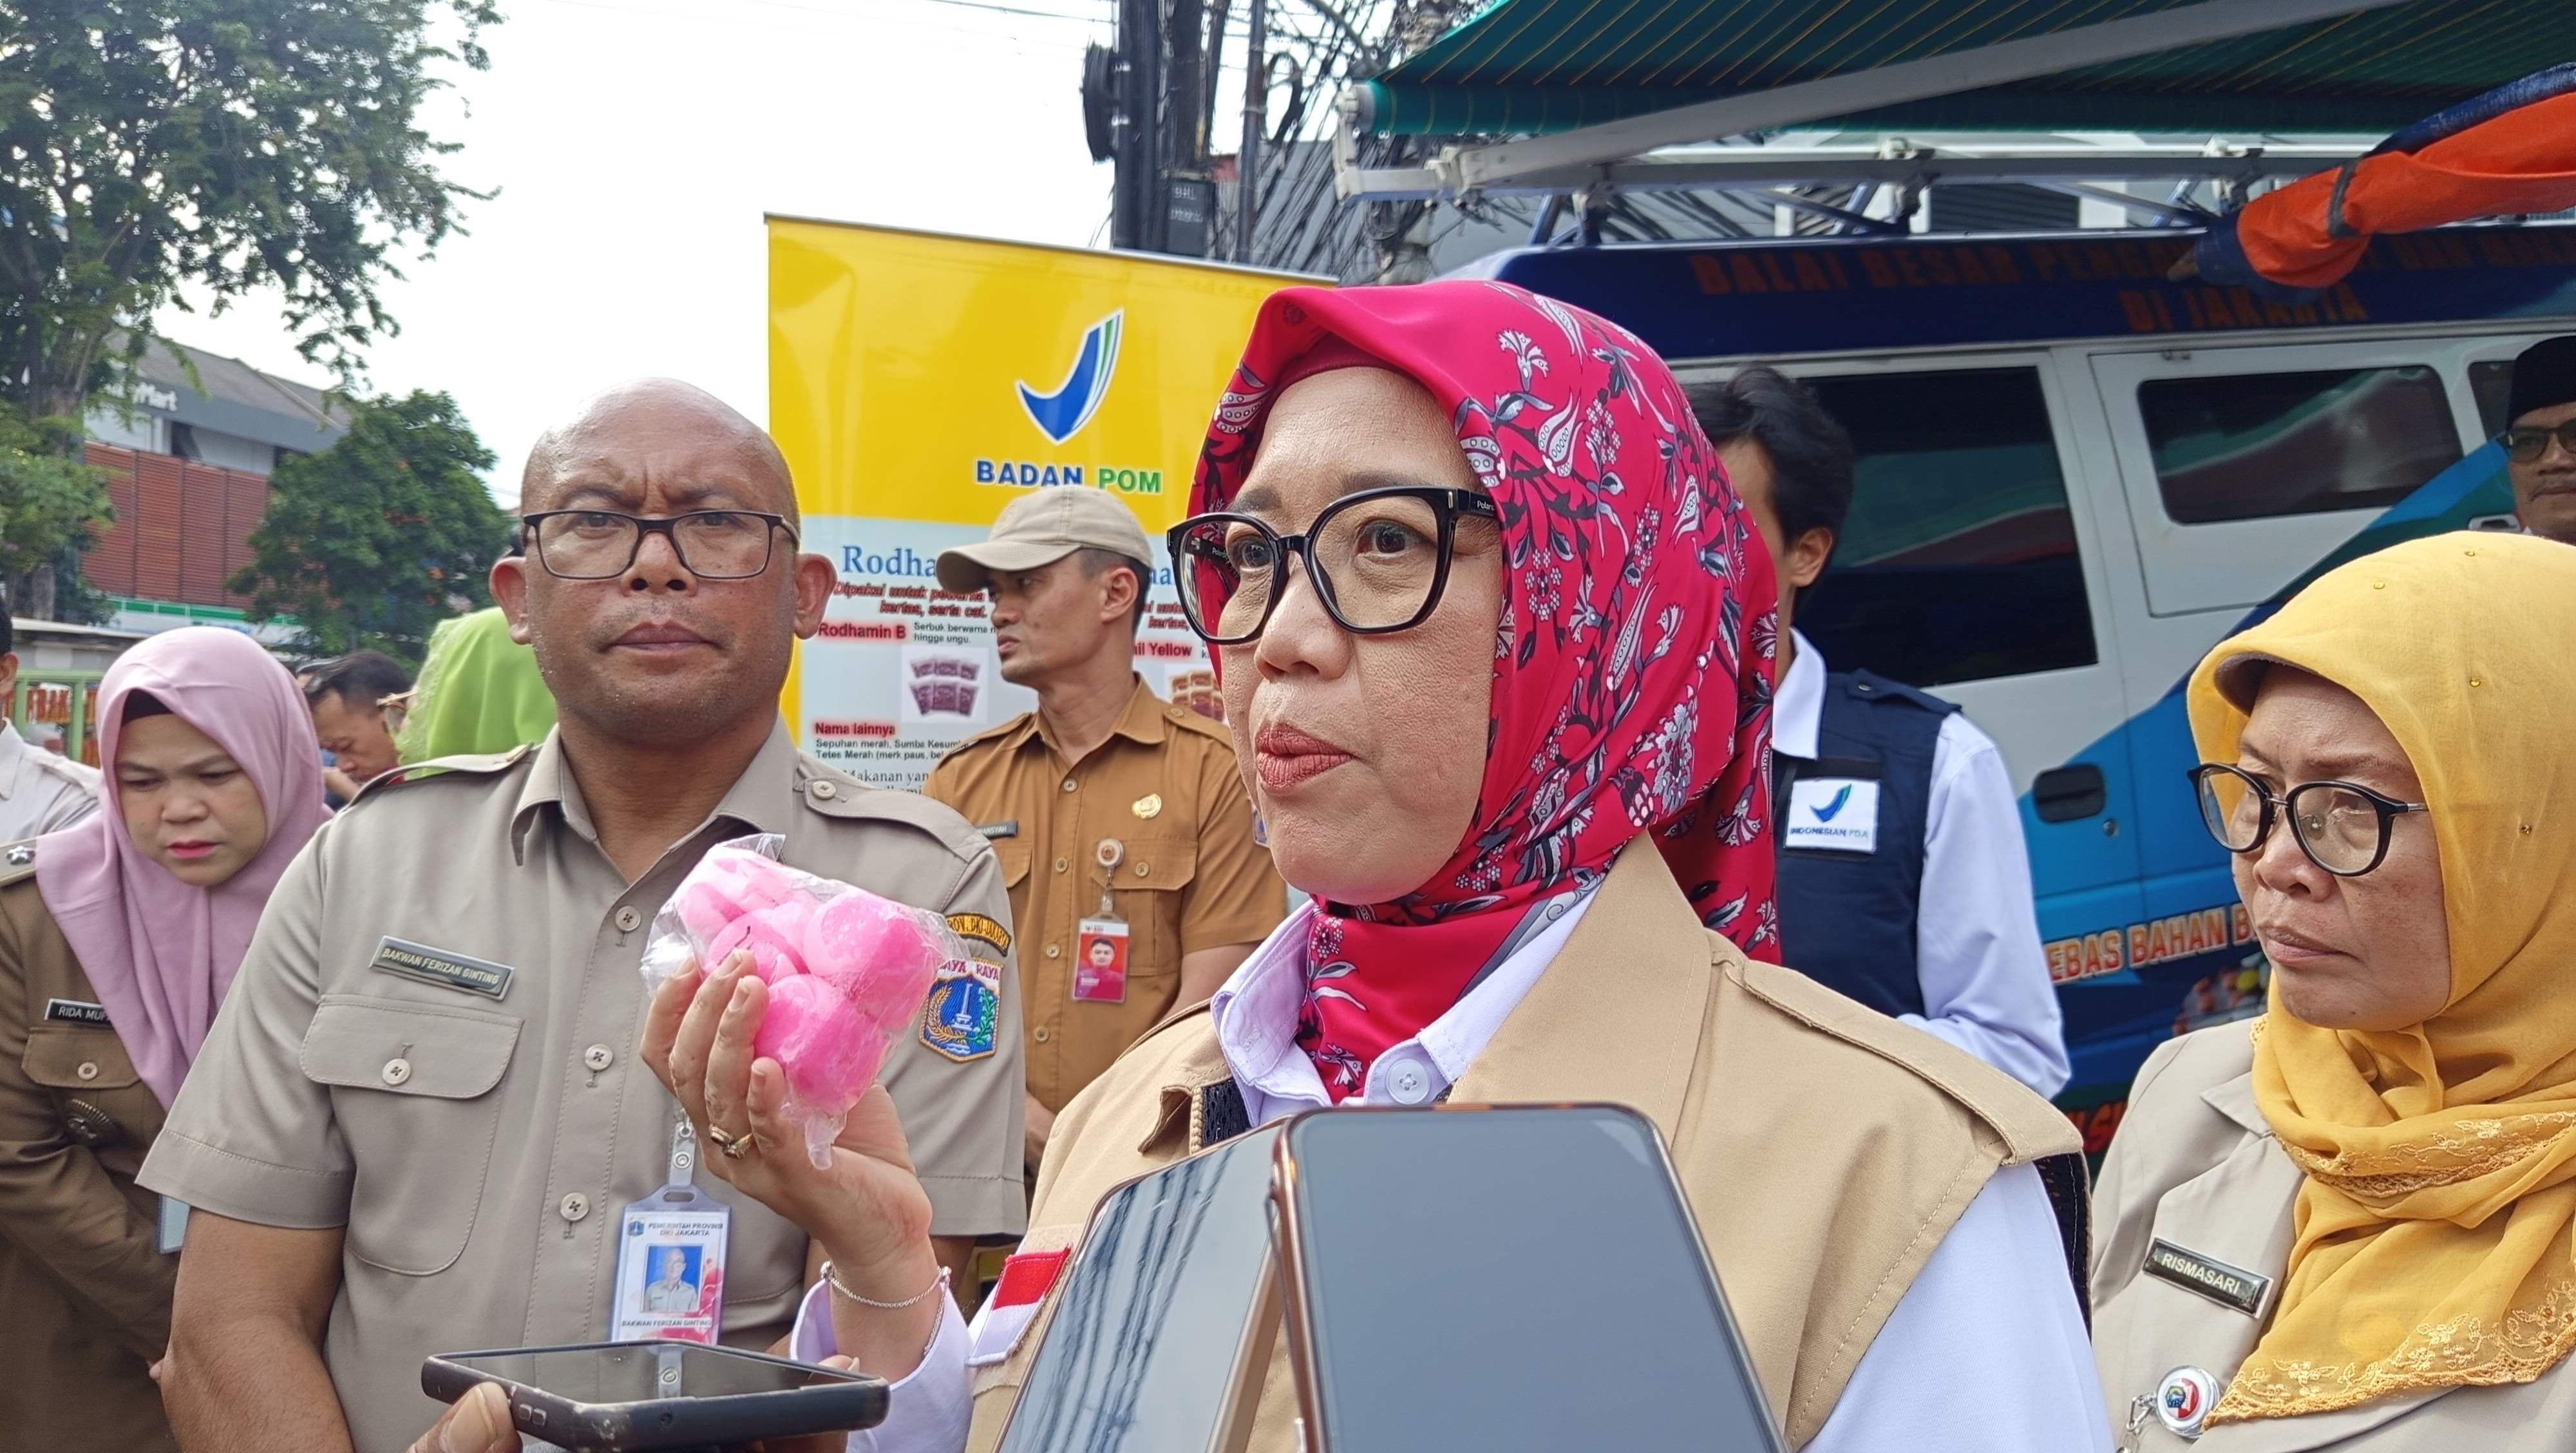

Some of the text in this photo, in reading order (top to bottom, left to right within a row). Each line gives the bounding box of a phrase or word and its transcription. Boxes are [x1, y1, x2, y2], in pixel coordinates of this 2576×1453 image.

[976, 460, 1161, 493] BADAN POM
[842, 545, 936, 578] Rodha
[819, 623, 907, 639] Rodhamin B
[914, 622, 945, 632] Serbuk
[947, 624, 989, 634] berwarna
[914, 632, 971, 645] hingga ungu.
[1150, 642, 1192, 656] Yellow
[815, 723, 895, 738] Nama lainnya
[816, 739, 961, 749] Sepuhan merah, Sumba Kesum
[816, 750, 842, 759] Tetes
[845, 750, 873, 759] Merah
[876, 750, 902, 760] (merk
[904, 752, 928, 761] paus,
[907, 772, 929, 786] yan
[1790, 827, 1846, 837] INDONESIAN
[947, 916, 969, 931] ROV.
[2045, 902, 2259, 984] EBAS BAHAN B
[382, 948, 500, 985] BAKWAN FERIZAN GINTING
[939, 959, 998, 981] AYA RAYA
[58, 1006, 82, 1018] RIDA
[2161, 1252, 2240, 1295] RISMASARI
